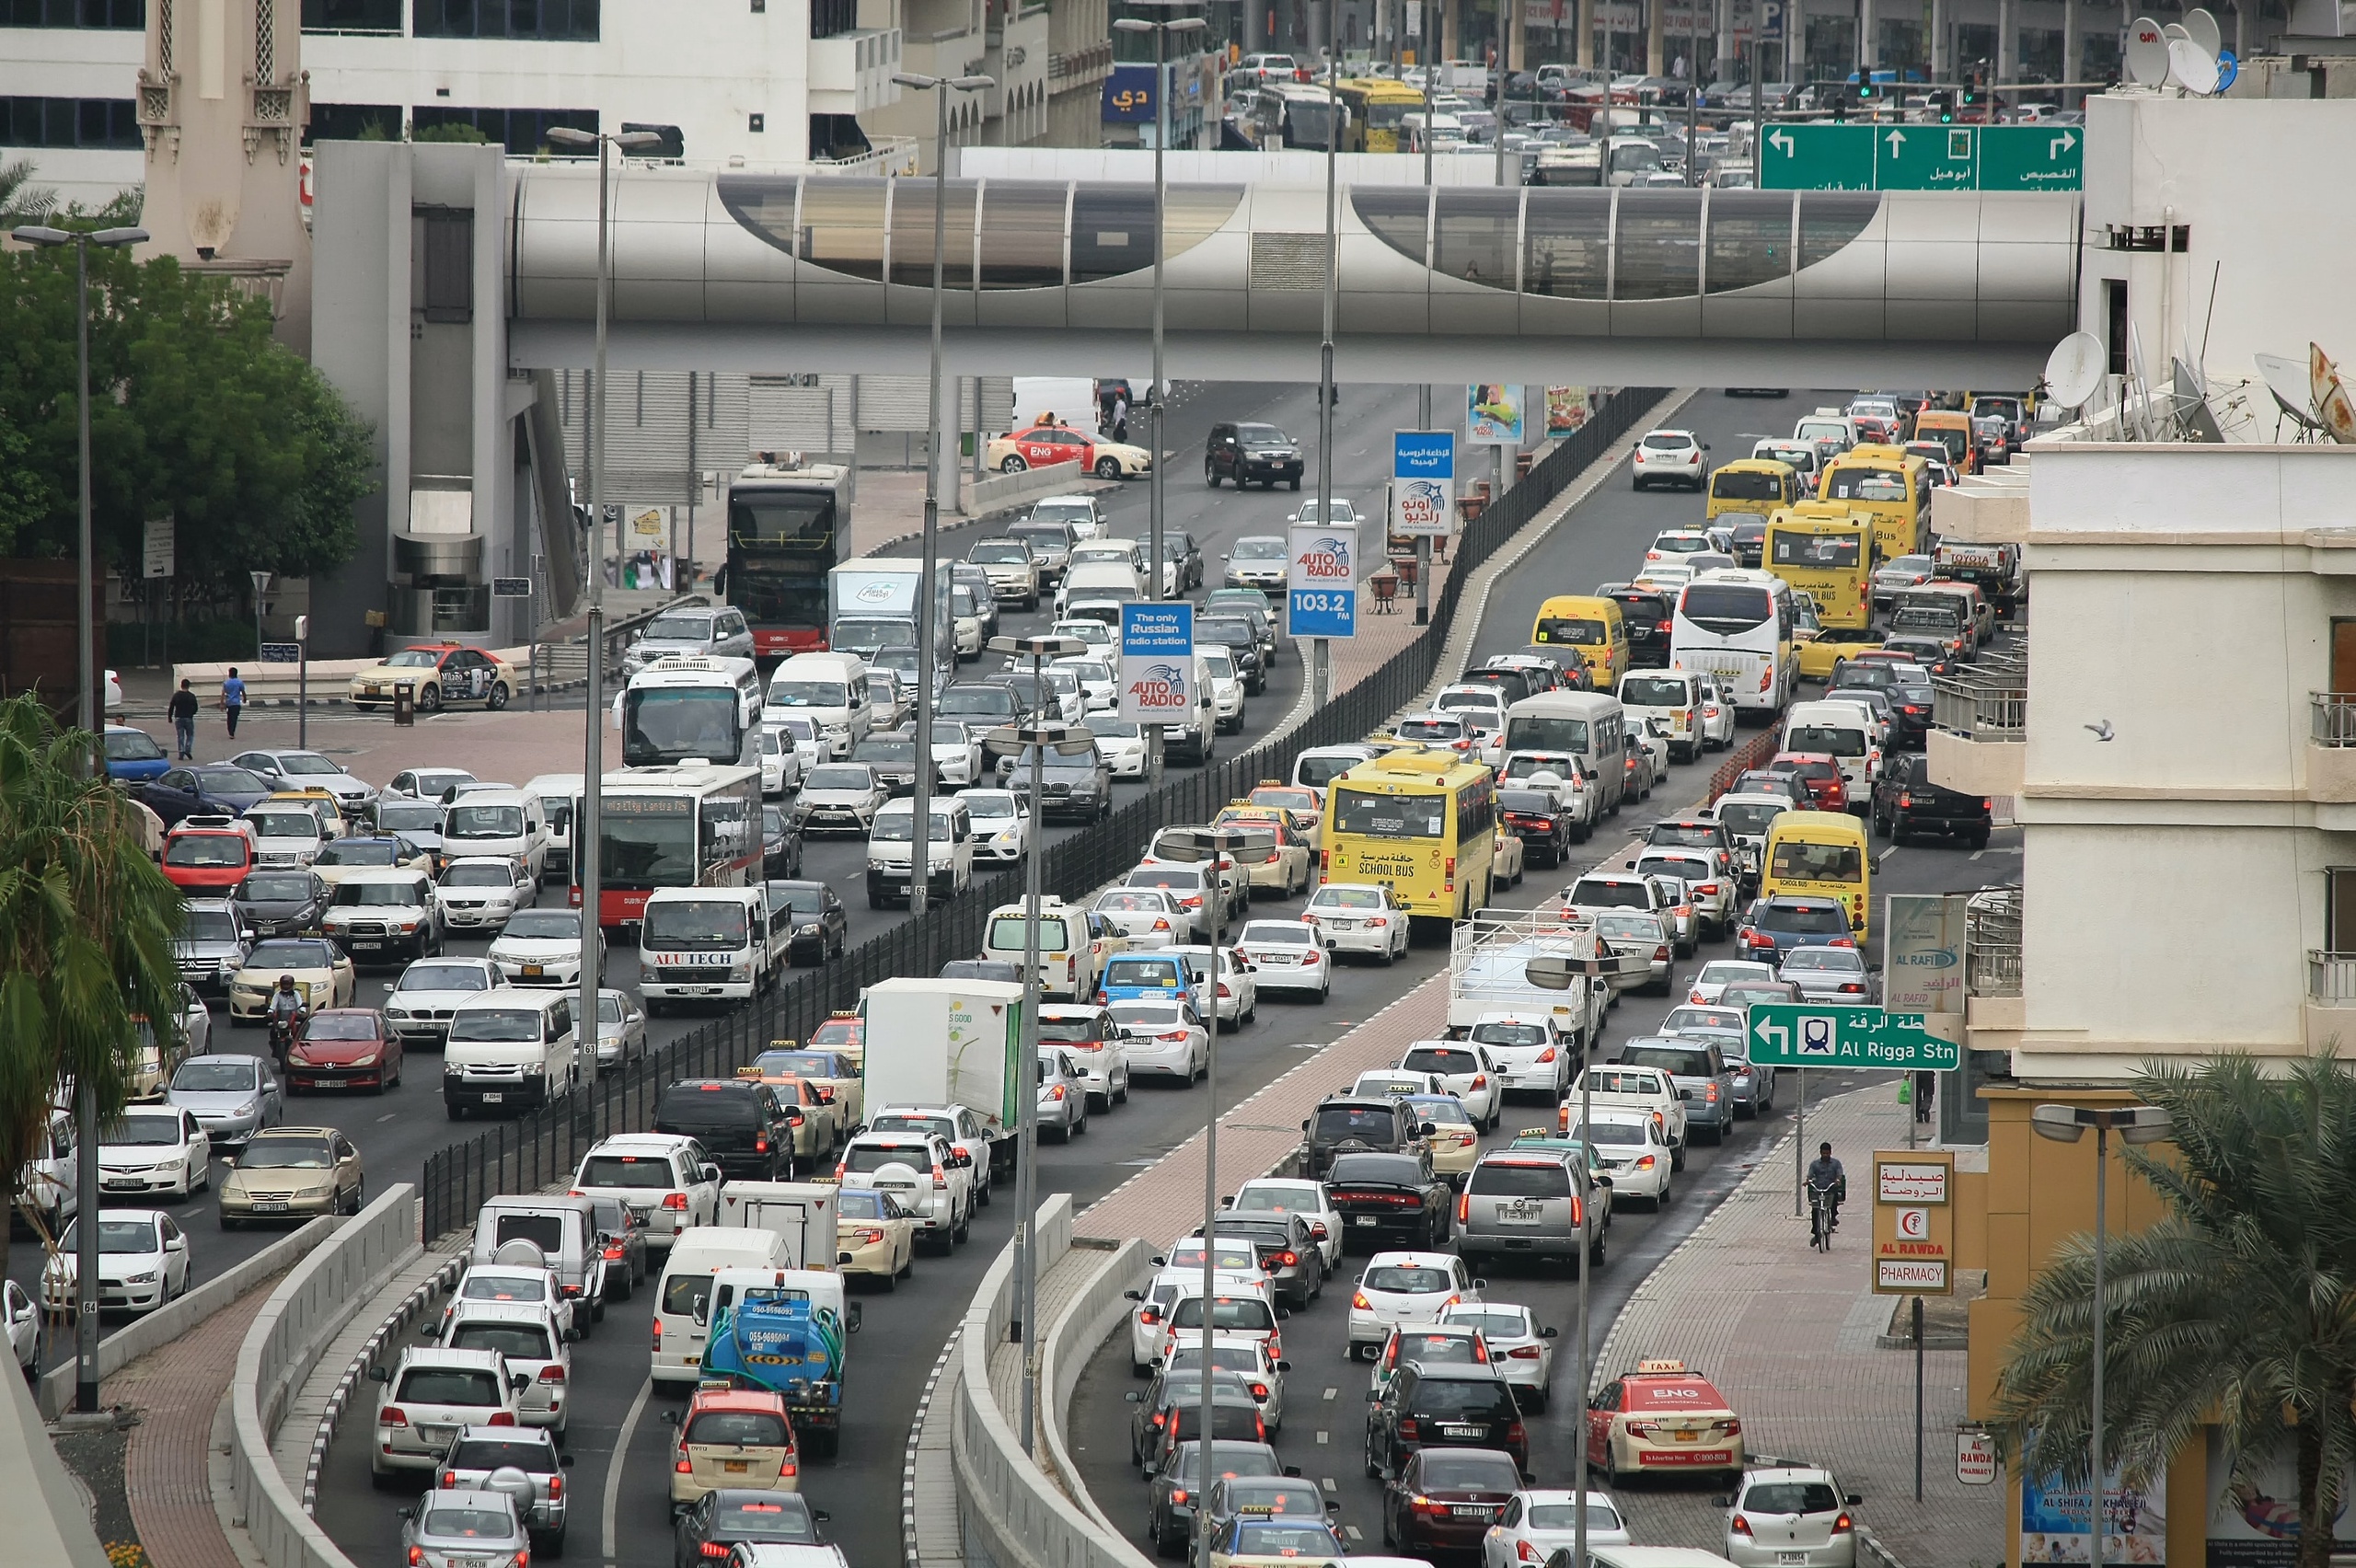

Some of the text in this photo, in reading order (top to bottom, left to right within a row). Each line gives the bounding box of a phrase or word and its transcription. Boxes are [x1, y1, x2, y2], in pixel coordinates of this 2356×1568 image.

[2020, 167, 2076, 181] القصيص
[1030, 446, 1052, 457] ENG
[1876, 531, 1897, 541] Bus
[1297, 553, 1334, 566] AUTO
[1951, 553, 1990, 564] TOYOTA
[1306, 565, 1350, 577] RADIO
[1821, 591, 1837, 601] BUS
[1293, 593, 1345, 611] 103.2
[1135, 613, 1178, 623] The only
[1337, 612, 1350, 620] FM
[1130, 623, 1180, 634] Russian
[1126, 637, 1187, 645] radio station
[1127, 681, 1170, 695] AUTO
[1139, 694, 1186, 707] RADIO
[1360, 851, 1415, 863] حافلة مدرسية
[1358, 861, 1415, 878] SCHOOL BUS
[1779, 879, 1798, 887] SCHOOL
[916, 886, 925, 895] 62
[1895, 955, 1909, 965] AL
[1890, 993, 1929, 1003] AL RAFID
[1848, 1012, 1888, 1032] الرقة
[584, 1044, 595, 1054] 63
[1841, 1042, 1954, 1061] Al Rigga Stn
[1880, 1168, 1944, 1183] صيدلية
[1881, 1185, 1944, 1199] الروضة
[1881, 1244, 1945, 1255] AL RAWDA
[1880, 1265, 1943, 1283] PHARMACY
[84, 1302, 96, 1313] 64
[1652, 1389, 1699, 1398] ENG
[1971, 1440, 1981, 1450] AL
[1960, 1453, 1992, 1463] RAWDA
[1960, 1468, 1992, 1476] PHARMACY
[2043, 1498, 2058, 1508] AL
[2058, 1497, 2085, 1508] SHIFA
